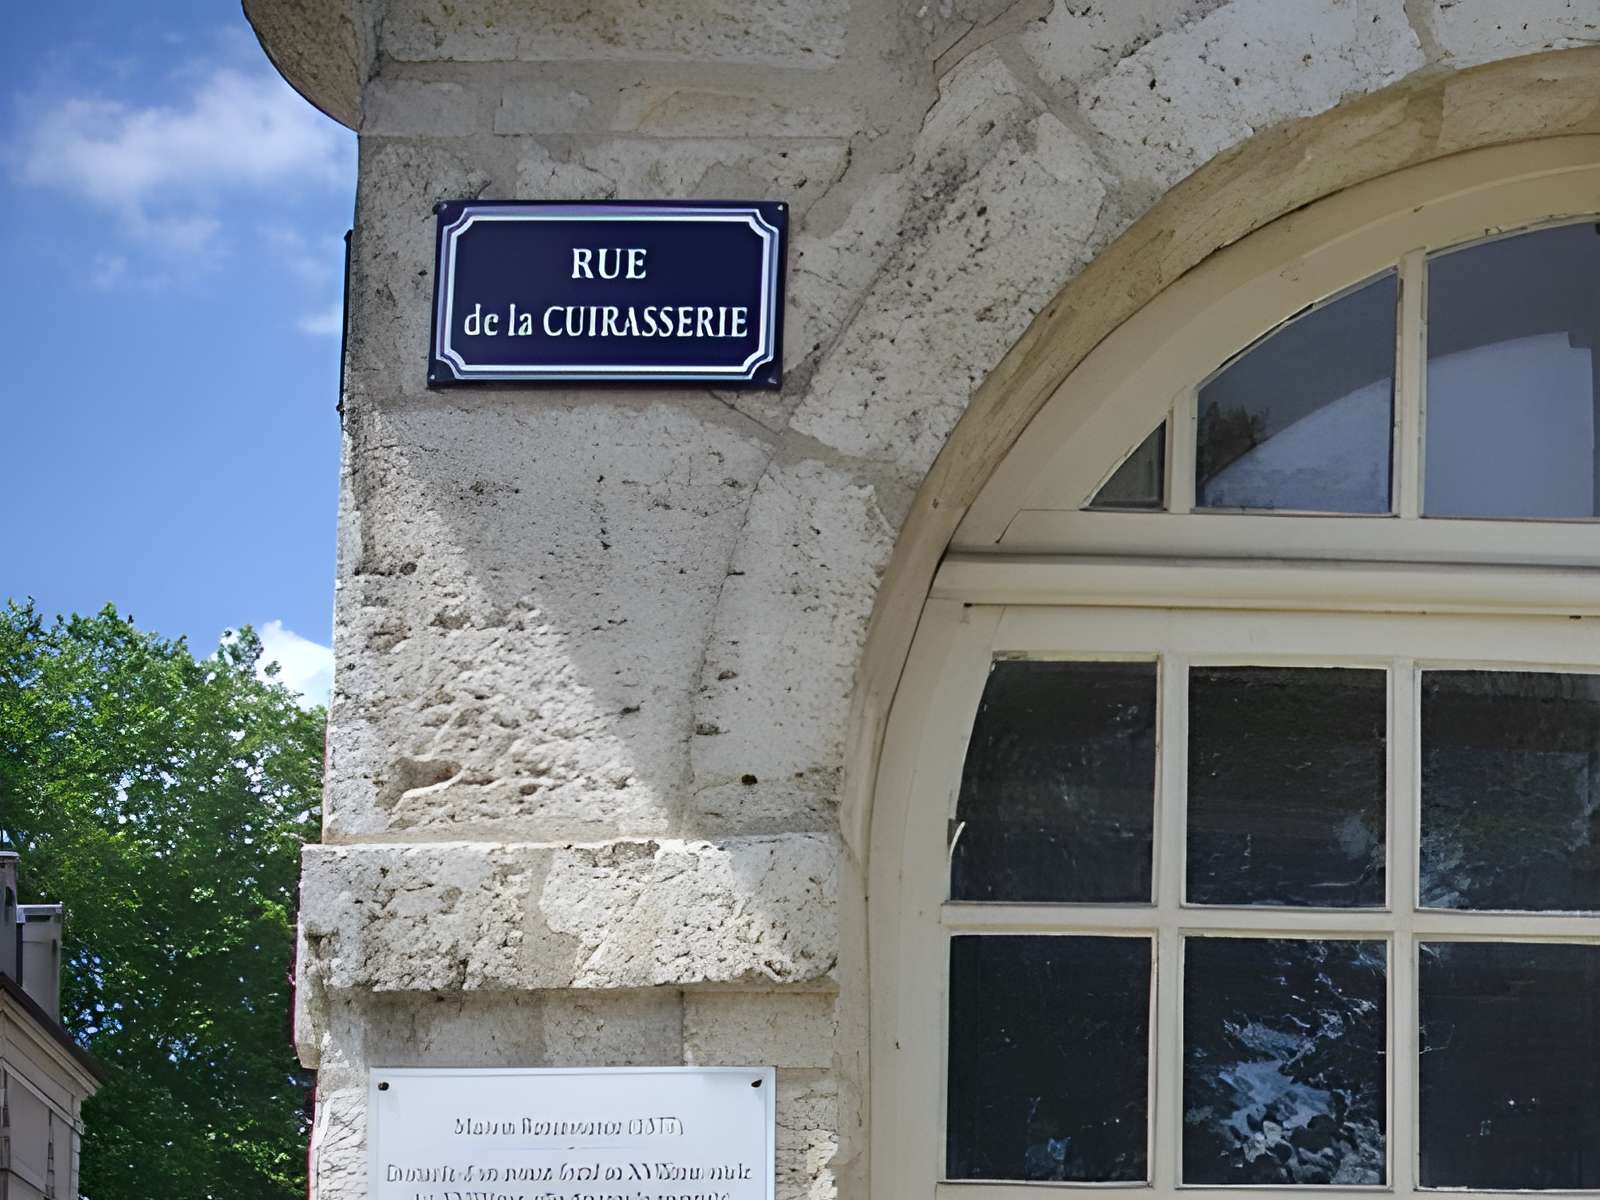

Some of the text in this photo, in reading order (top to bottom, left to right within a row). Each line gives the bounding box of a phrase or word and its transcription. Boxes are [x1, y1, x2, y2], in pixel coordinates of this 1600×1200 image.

[571, 248, 647, 280] RUE
[463, 303, 748, 338] de la CUIRASSERIE
